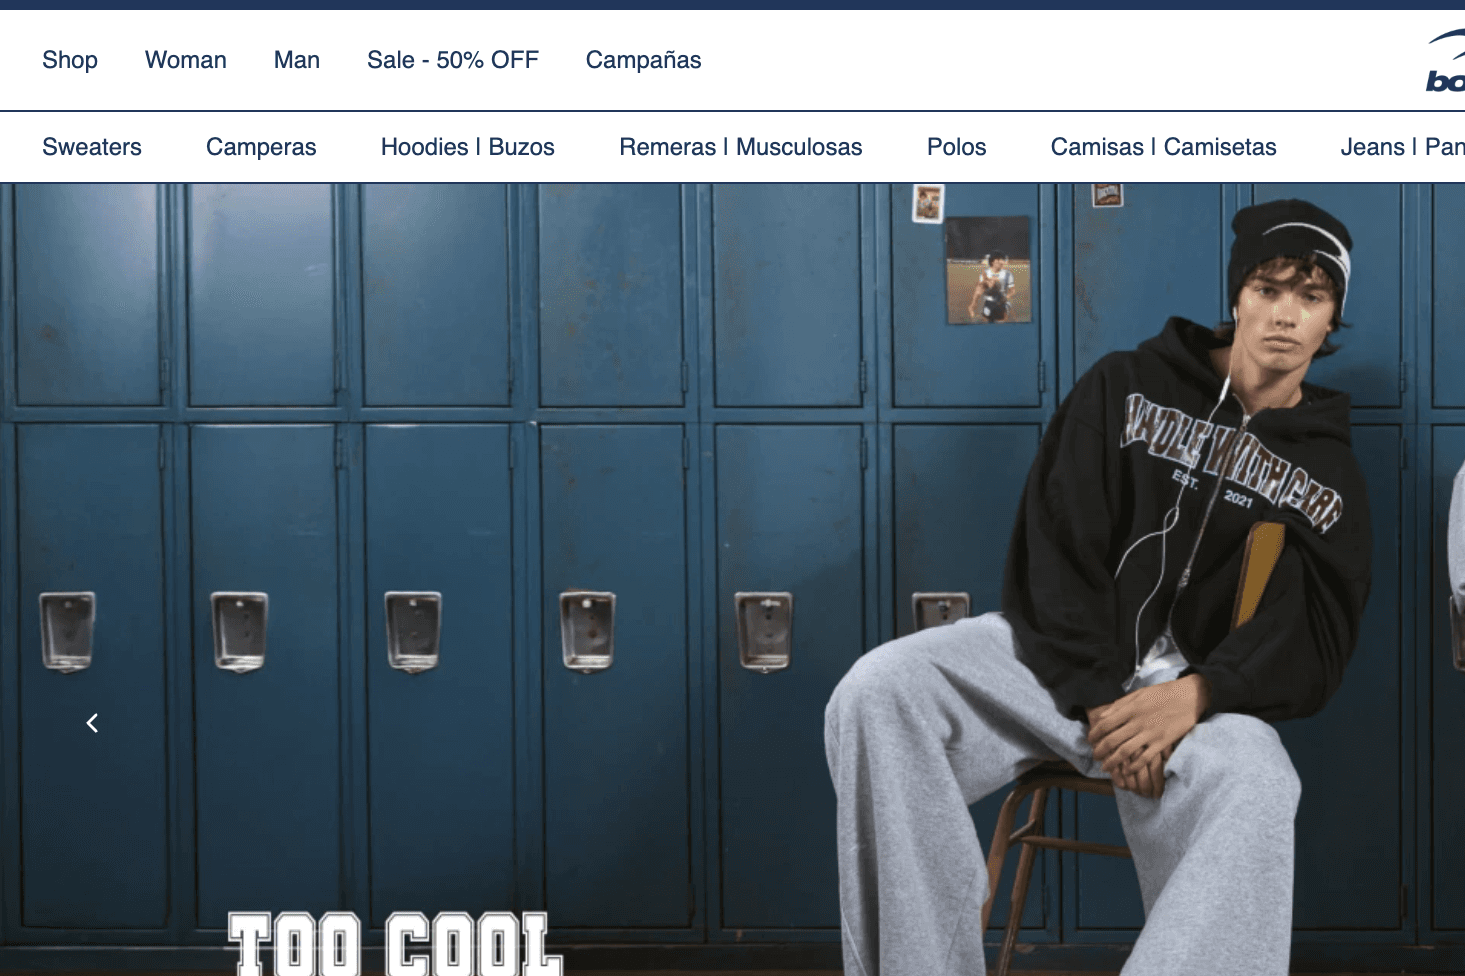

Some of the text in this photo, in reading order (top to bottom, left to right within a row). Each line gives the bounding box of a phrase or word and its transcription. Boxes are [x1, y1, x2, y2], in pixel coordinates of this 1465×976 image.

[43, 50, 97, 73] Shop
[145, 50, 226, 69] Woman
[275, 50, 319, 69] Man
[368, 50, 414, 69] Sale
[437, 50, 485, 69] 50%
[492, 50, 539, 69] OFF
[587, 50, 701, 73] Campañas
[43, 137, 141, 156] Sweaters
[207, 137, 316, 160] Camperas
[382, 137, 468, 156] Hoodies
[490, 137, 554, 156] Buzos
[621, 137, 716, 156] Remeras
[737, 137, 862, 156] Musculosas
[929, 137, 986, 156] Polos
[1052, 137, 1144, 156] Camisas
[1165, 137, 1276, 156] Camisetas
[1341, 137, 1405, 156] Jeans
[1223, 490, 1254, 509] 2021
